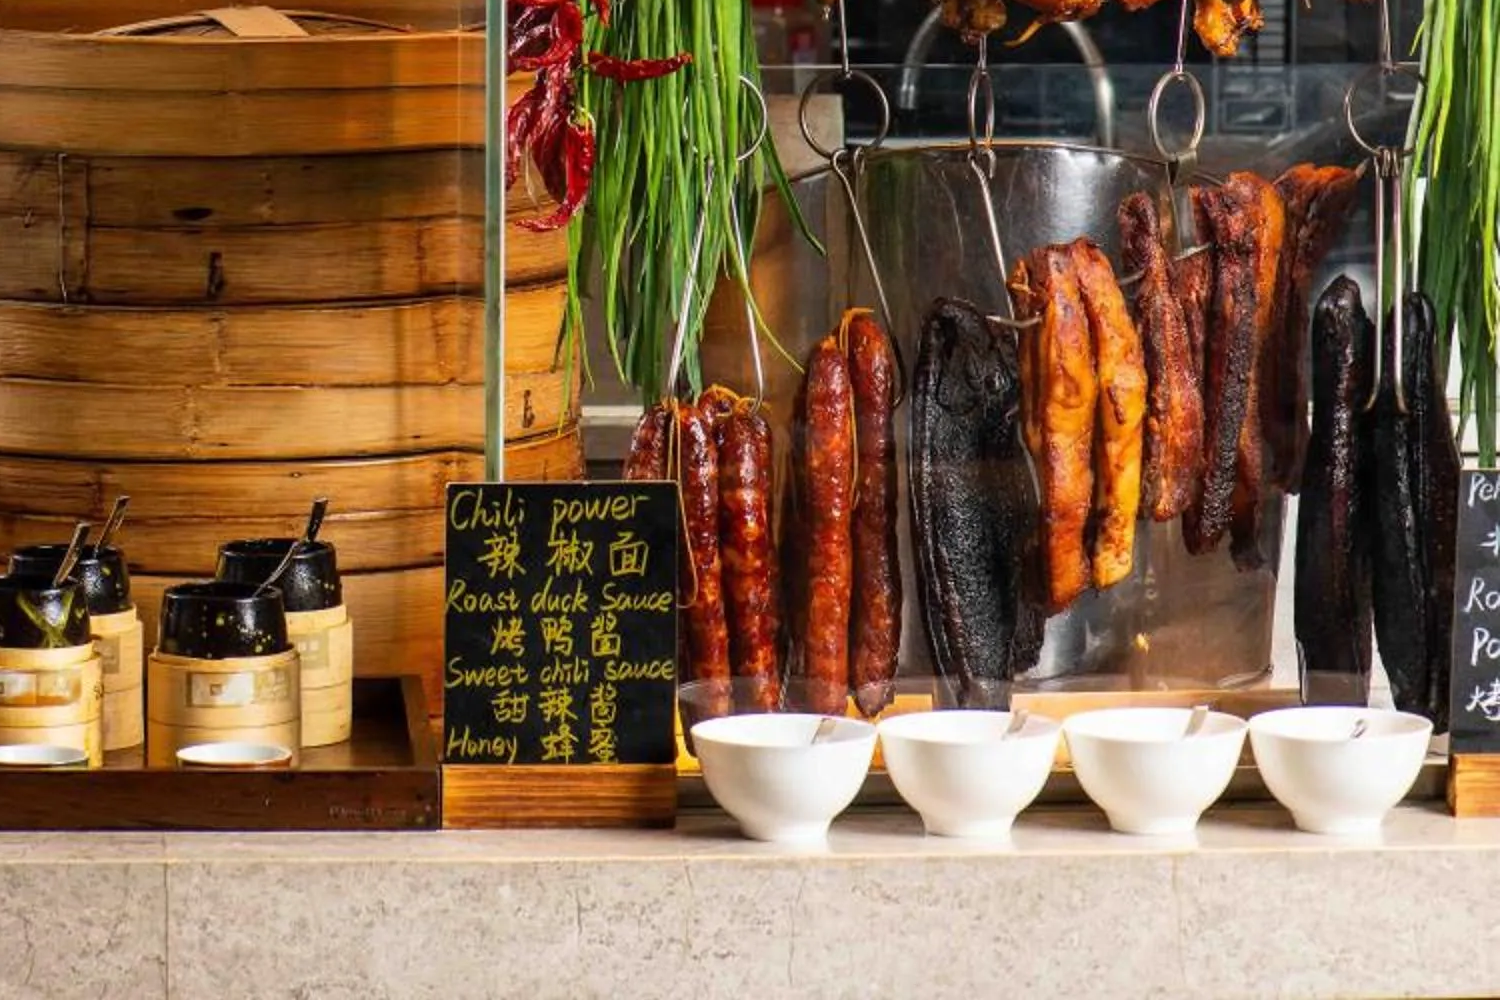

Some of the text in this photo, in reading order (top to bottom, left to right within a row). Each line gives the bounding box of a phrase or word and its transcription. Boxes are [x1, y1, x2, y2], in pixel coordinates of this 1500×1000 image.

[450, 487, 649, 539] Chili power
[447, 578, 521, 613] Roast
[531, 575, 590, 613] duck
[444, 655, 529, 689] Sweet
[539, 655, 590, 685] chili
[446, 724, 518, 765] Honey
